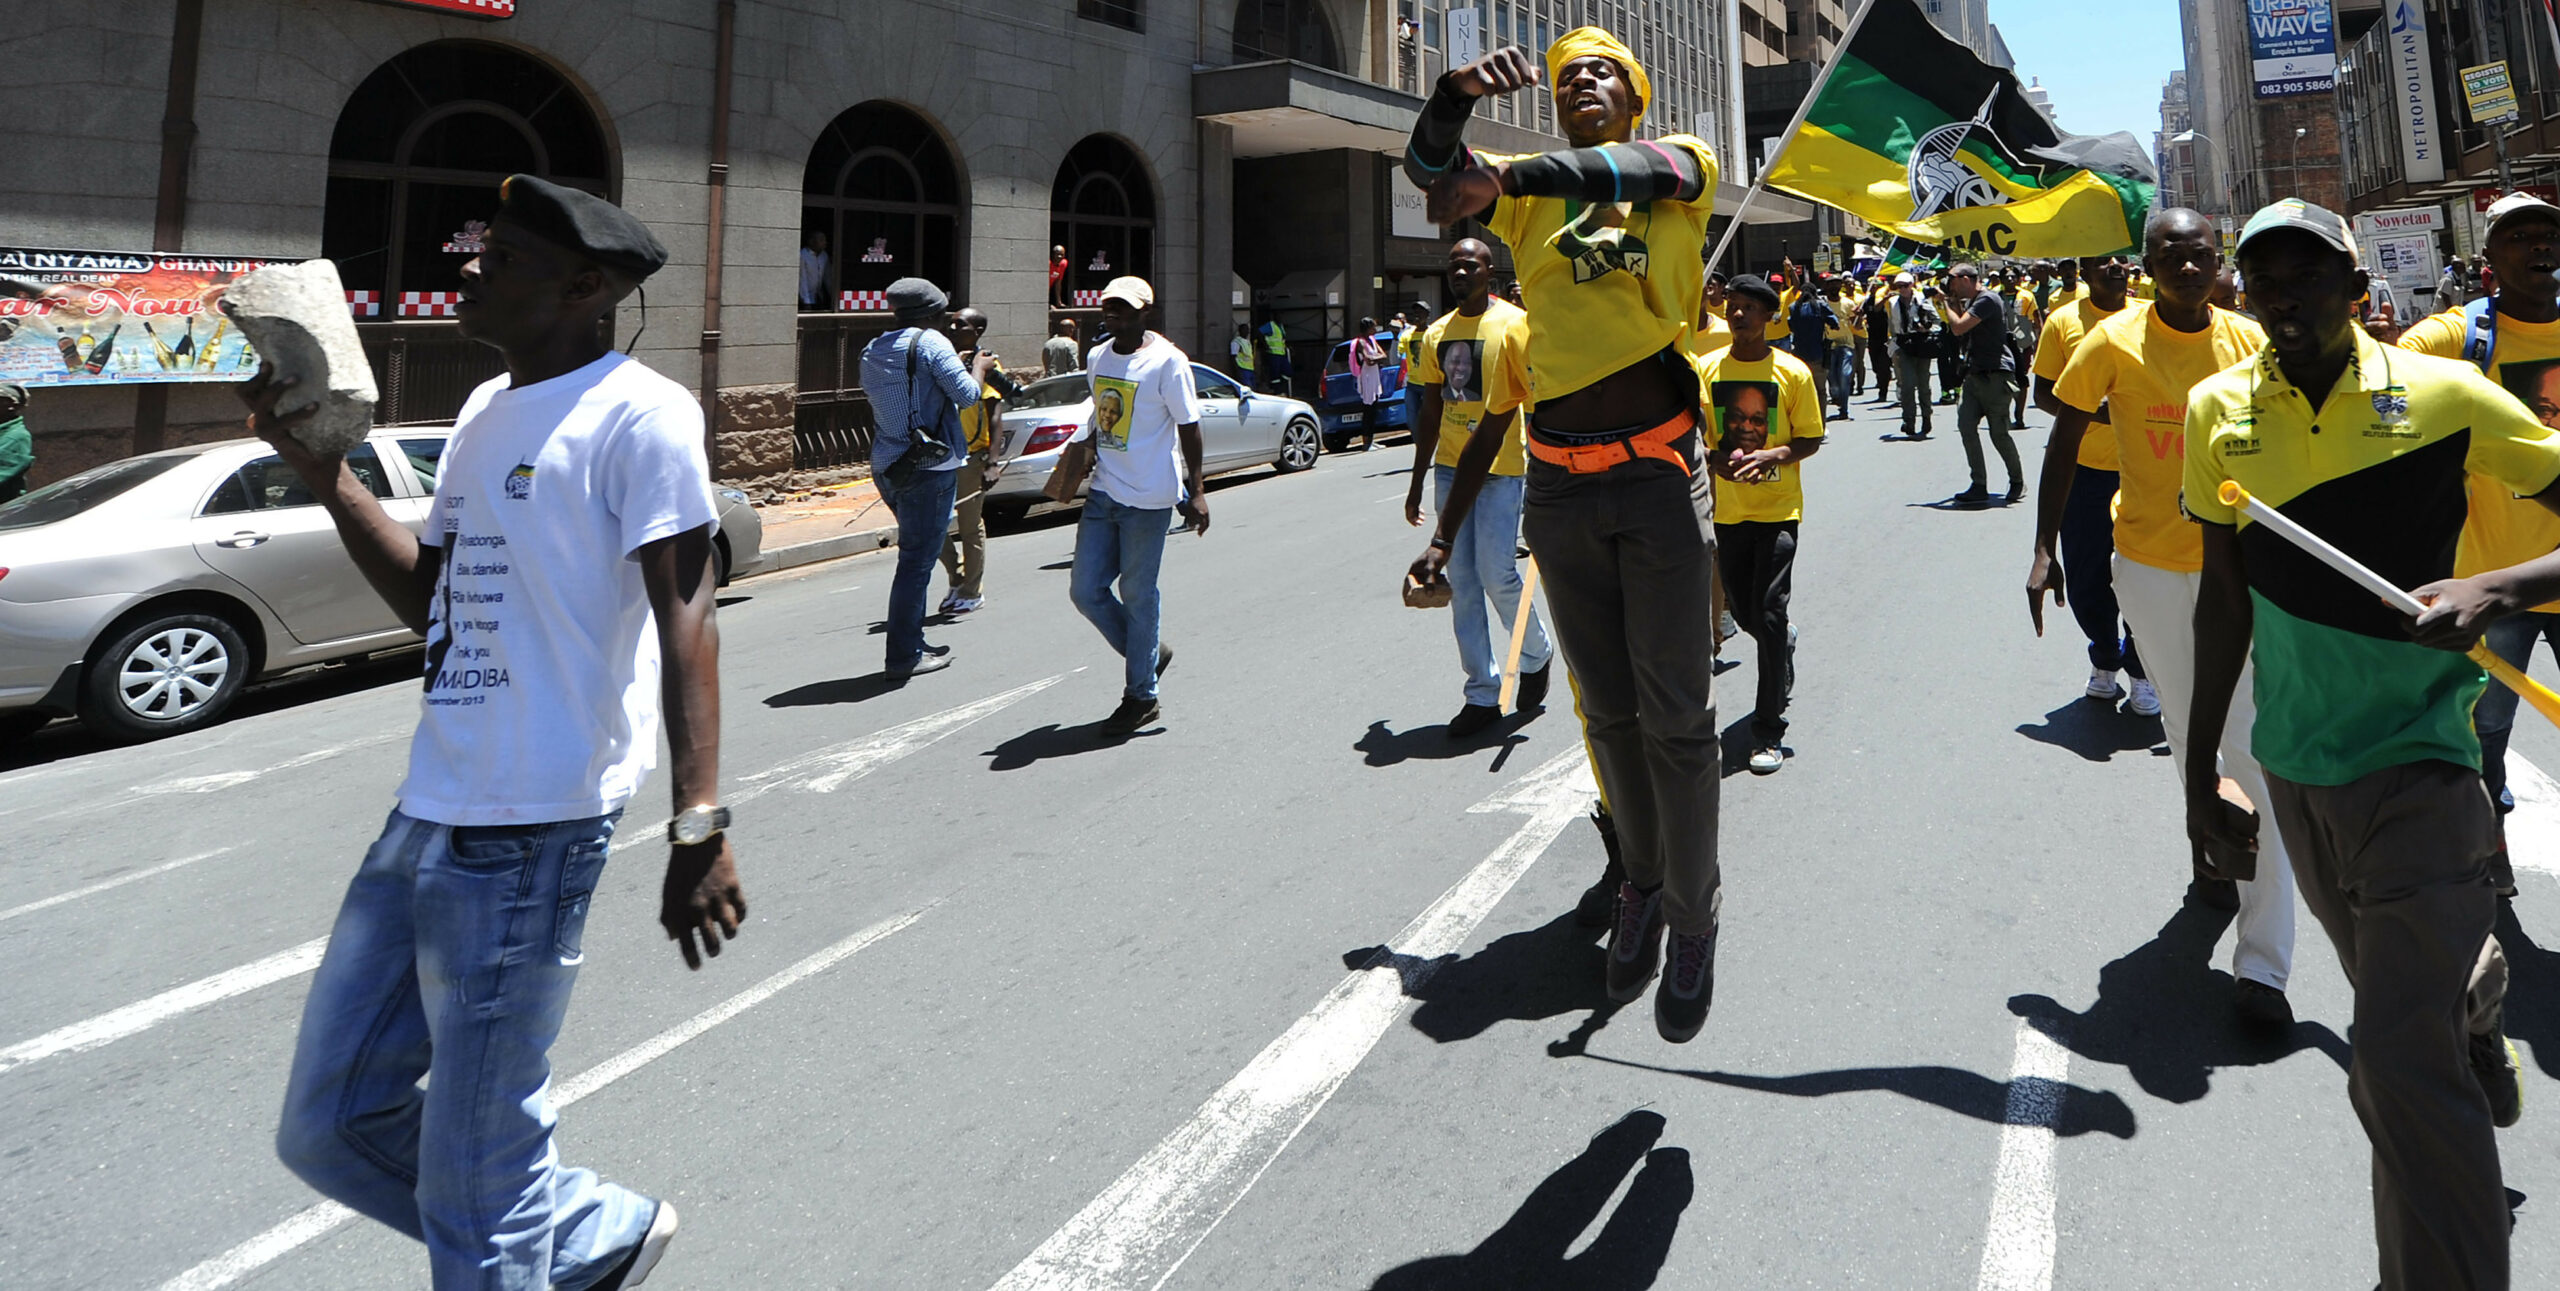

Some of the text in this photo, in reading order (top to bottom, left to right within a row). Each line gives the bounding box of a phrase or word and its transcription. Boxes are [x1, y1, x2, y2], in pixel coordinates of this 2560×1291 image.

[2253, 10, 2328, 38] WAVE
[1458, 14, 1470, 65] UNIS
[2464, 66, 2505, 81] REGISTER
[2261, 80, 2333, 95] 082 905 5866
[2468, 75, 2506, 89] TO VOTE
[2402, 34, 2429, 161] METROPOLITAN
[1394, 193, 1422, 210] UNISA
[2374, 213, 2432, 229] Sowetan
[35, 253, 144, 269] NYAMA
[159, 258, 250, 273] GHANDI
[42, 275, 78, 284] REAL
[85, 287, 206, 318] Now
[472, 562, 509, 576] dankie
[473, 647, 490, 660] you
[435, 668, 510, 690] MADIBA
[461, 695, 485, 706] 2013
